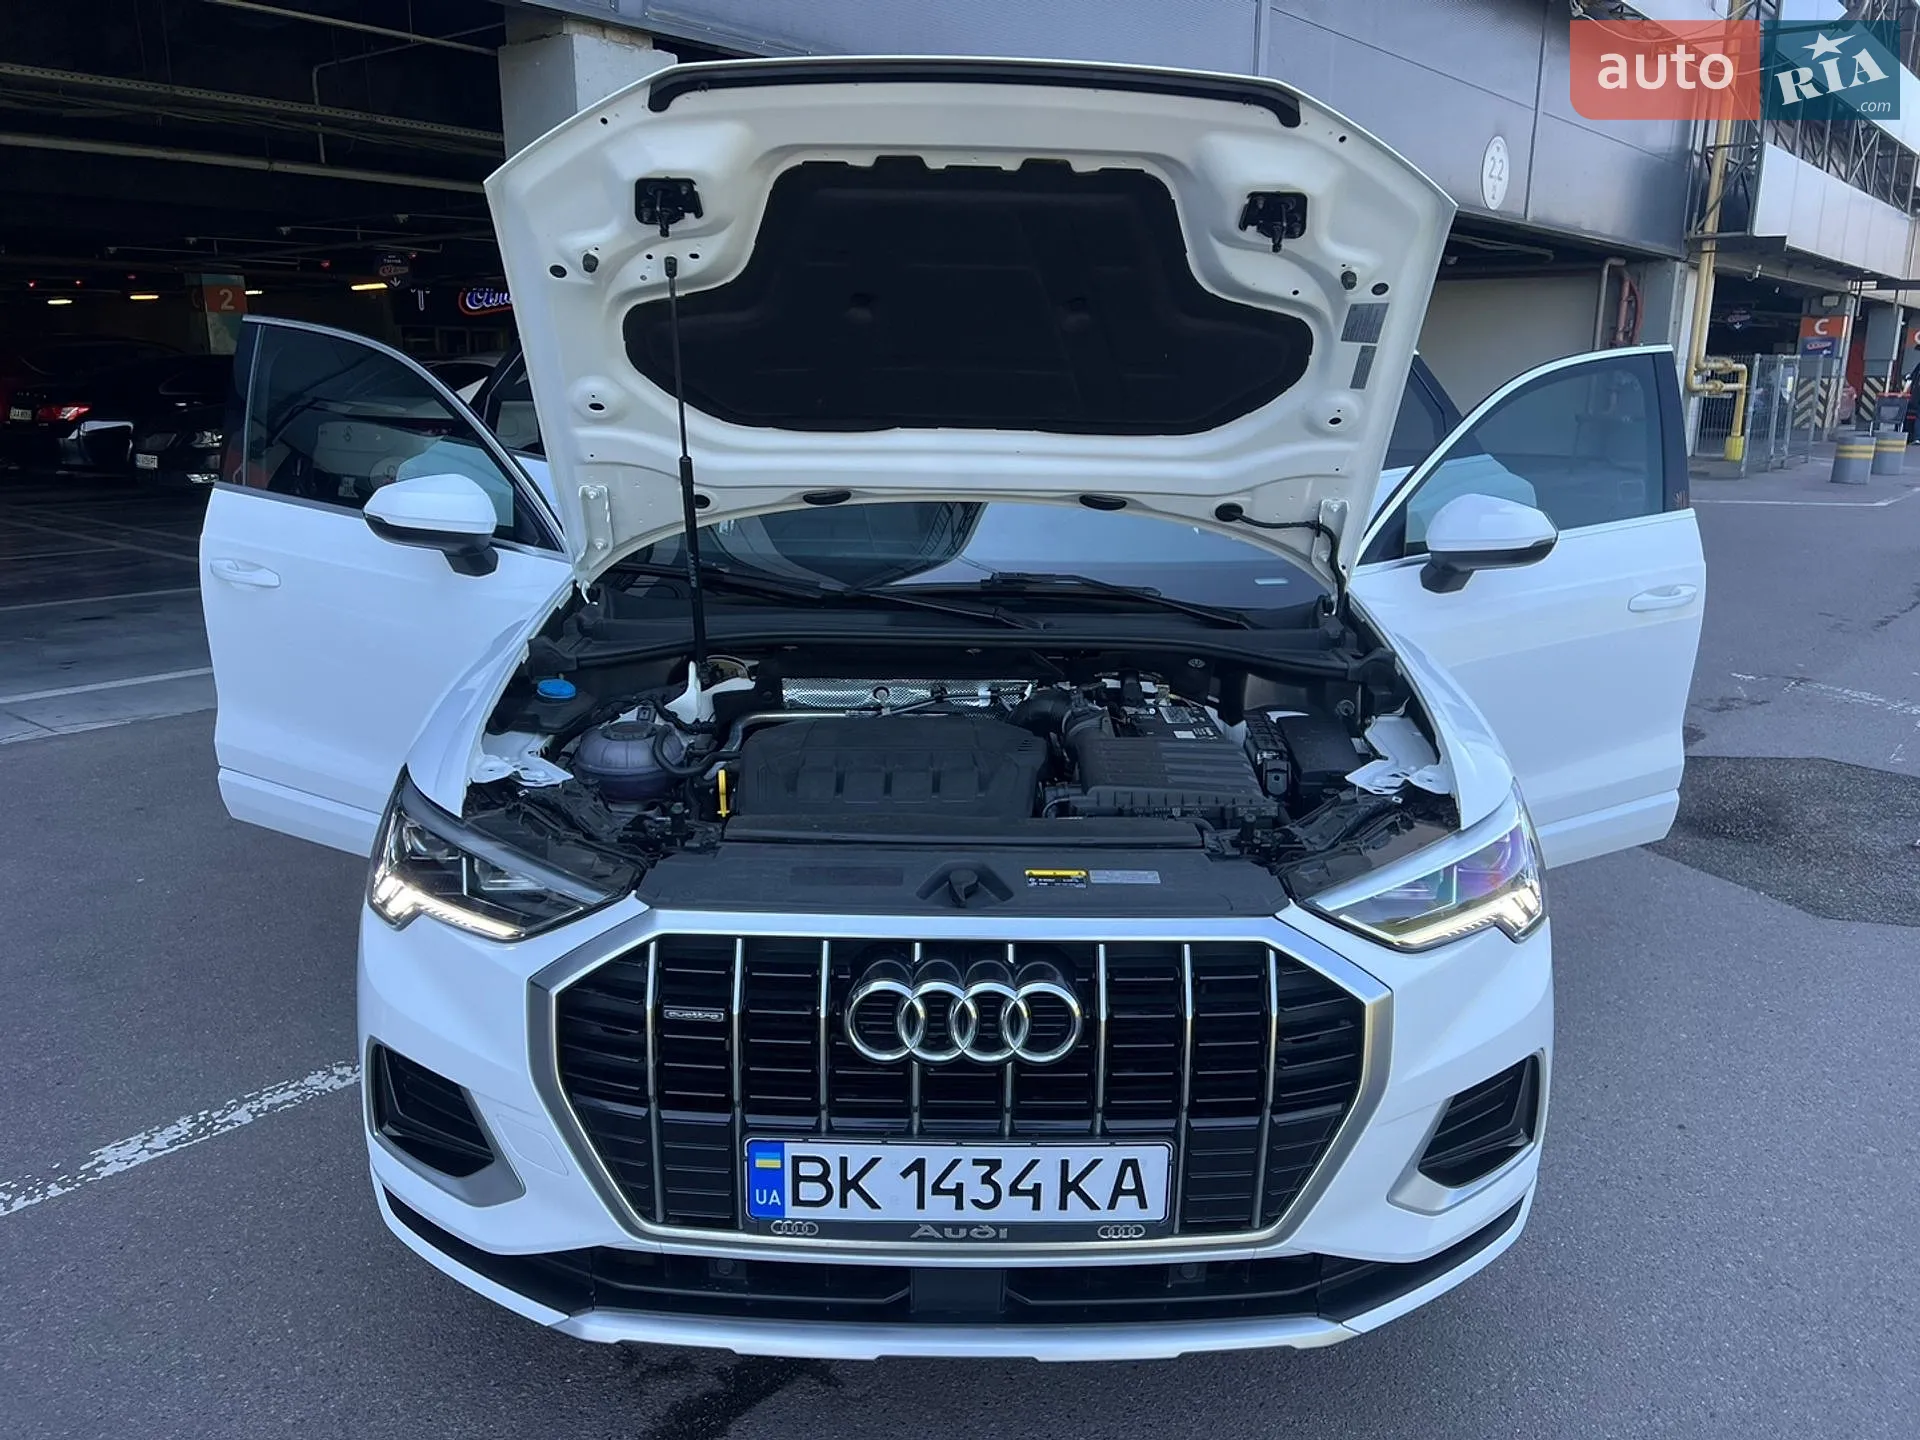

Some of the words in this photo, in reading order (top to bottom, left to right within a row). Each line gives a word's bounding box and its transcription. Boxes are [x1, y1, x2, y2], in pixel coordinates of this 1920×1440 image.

[1488, 156, 1504, 181] 22
[219, 288, 235, 311] 2
[1814, 318, 1830, 336] C
[755, 1189, 781, 1207] UA
[790, 1154, 883, 1211] BK
[899, 1157, 1043, 1212] 1434
[1058, 1157, 1149, 1212] KA
[909, 1223, 1008, 1240] Audi
